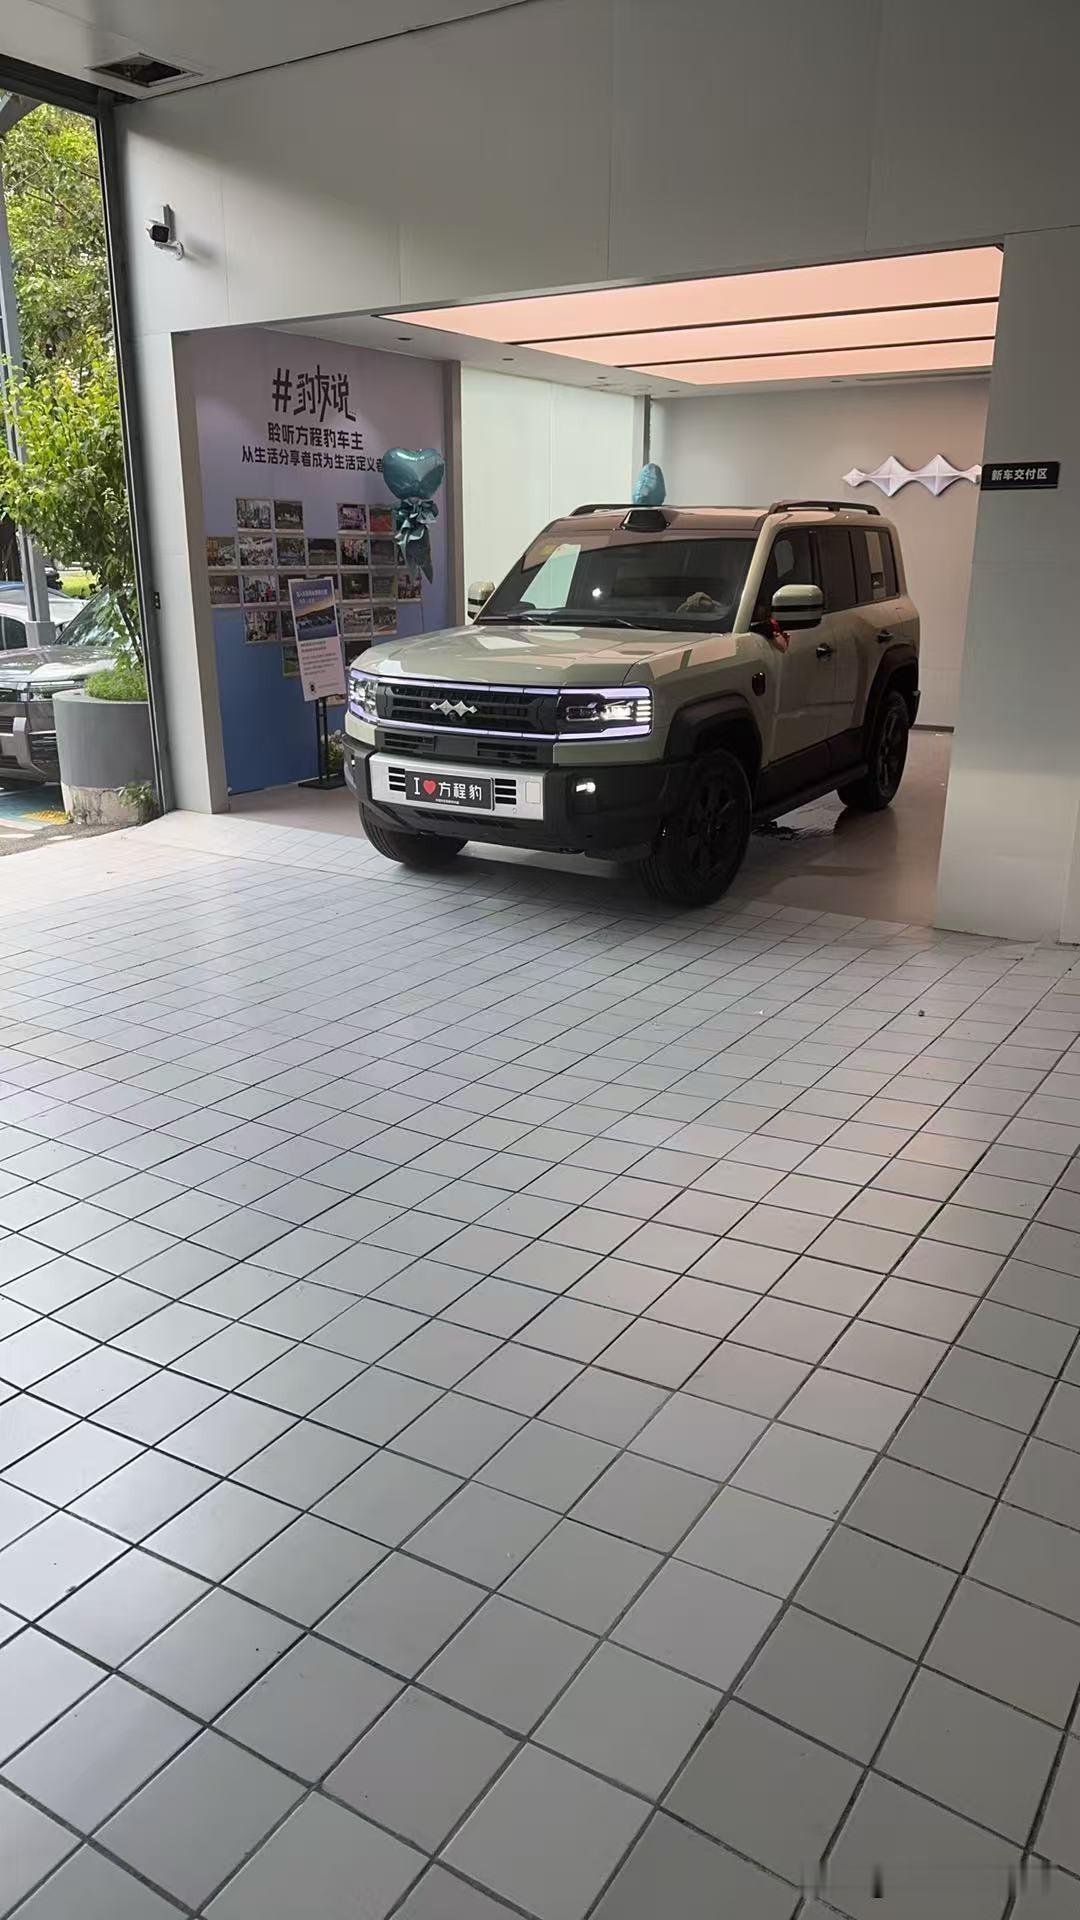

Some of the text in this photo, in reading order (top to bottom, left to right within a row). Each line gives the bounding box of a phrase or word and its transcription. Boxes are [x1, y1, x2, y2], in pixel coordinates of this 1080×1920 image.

[267, 422, 364, 450] 聆听方程豹车主
[991, 468, 1048, 481] 新车交付区
[413, 777, 482, 801] I 方程豹
